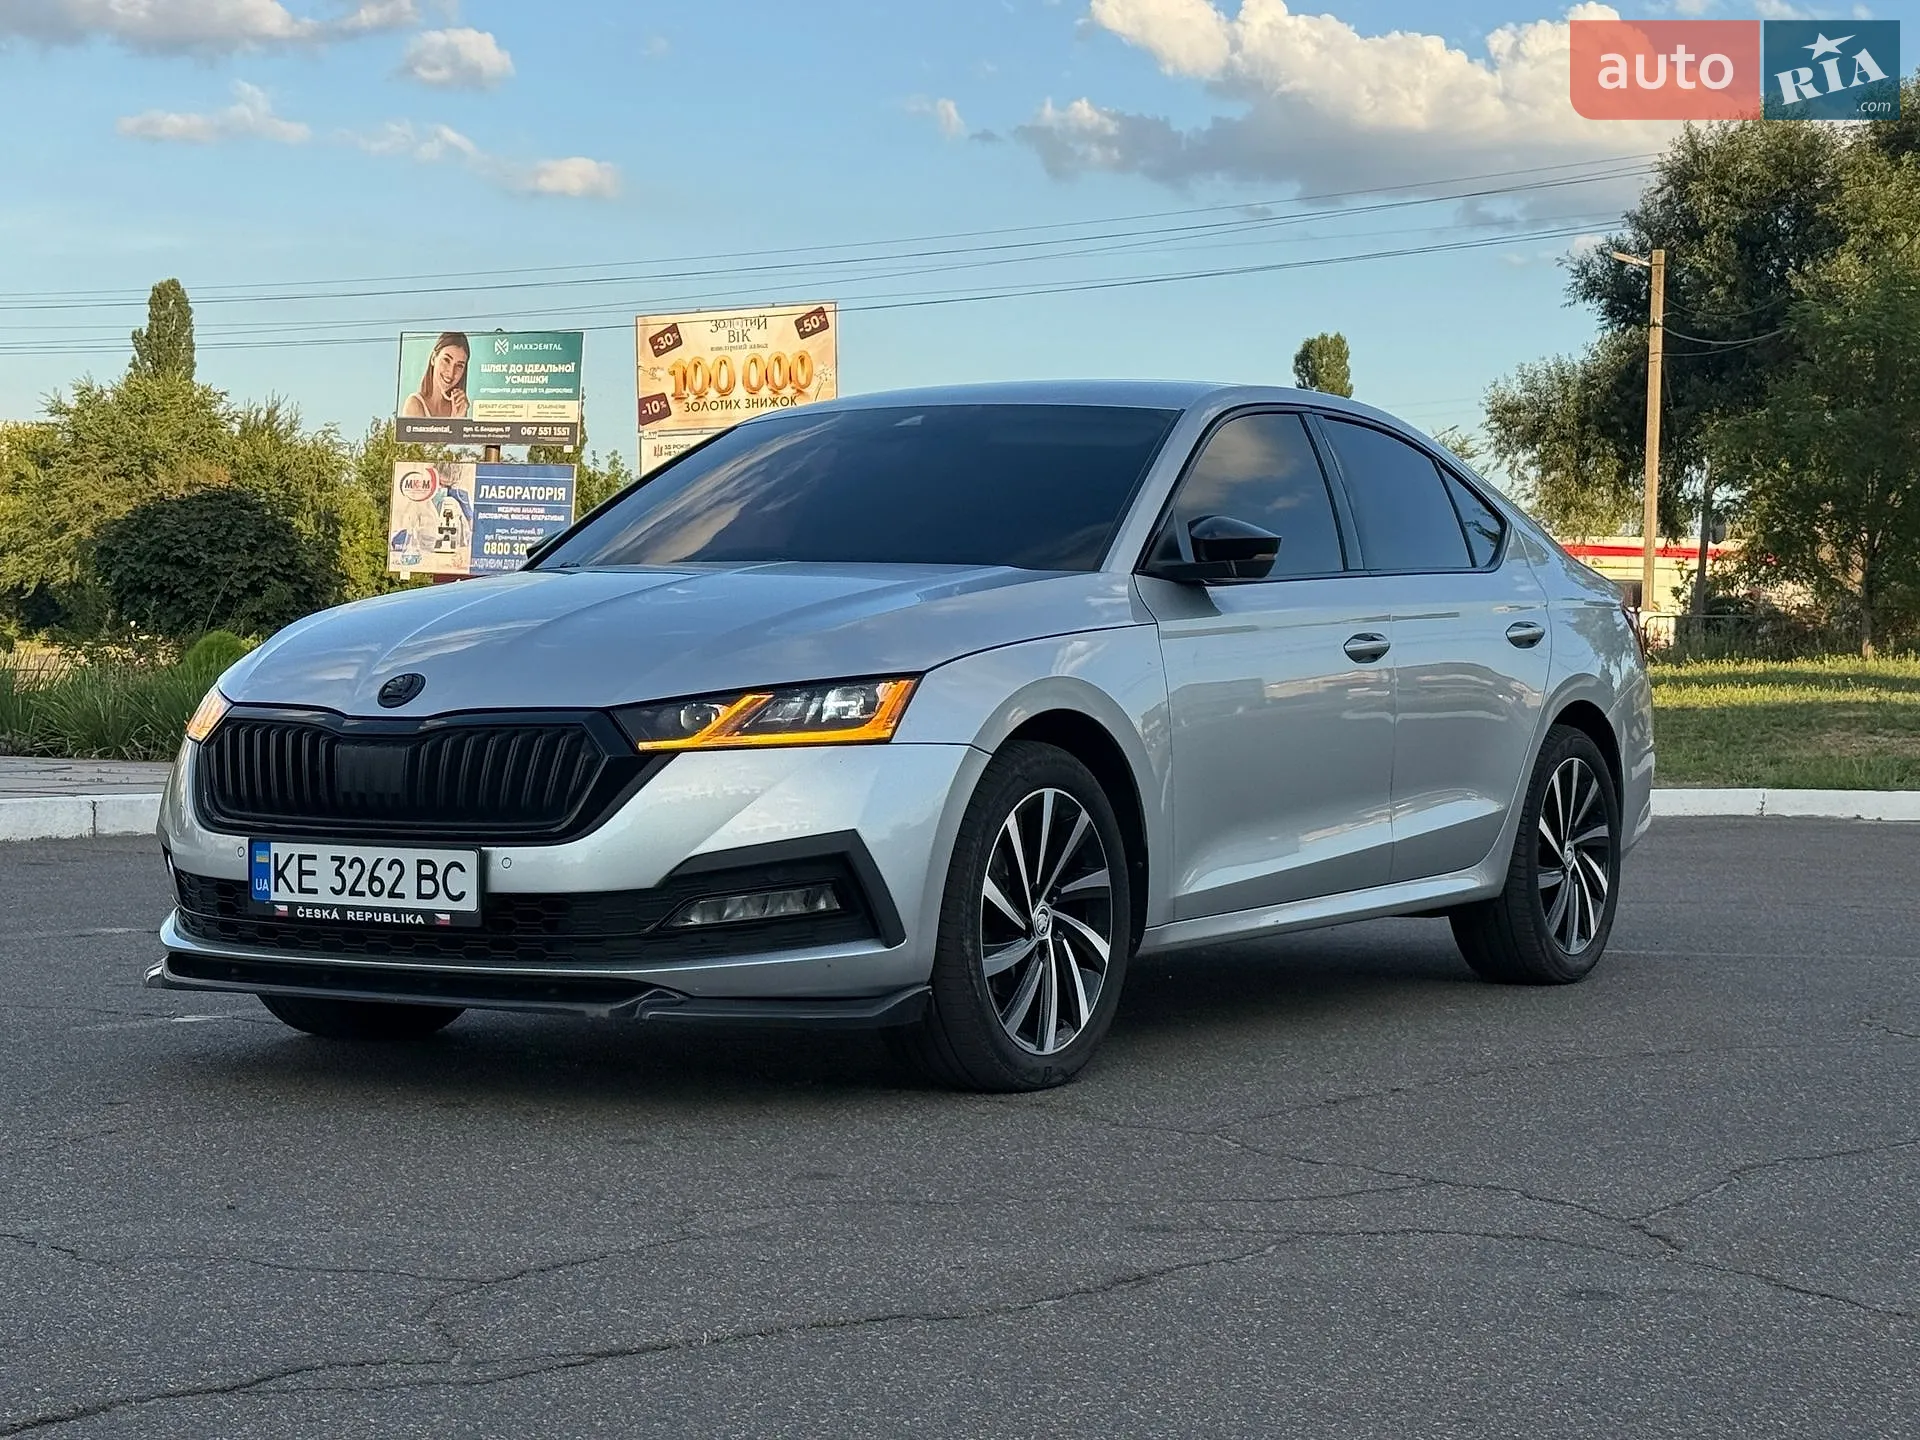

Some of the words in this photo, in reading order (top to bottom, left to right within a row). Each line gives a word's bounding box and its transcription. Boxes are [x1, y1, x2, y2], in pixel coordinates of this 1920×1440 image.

[480, 364, 508, 373] ШЛЯХ
[509, 364, 523, 374] ДО
[525, 362, 575, 373] ІДЕАЛЬНОЇ
[668, 355, 735, 399] 100
[743, 351, 814, 394] 000
[505, 375, 548, 384] УСМІШКИ
[684, 398, 740, 413] ЗОЛОТИХ
[745, 396, 797, 409] ЗНИЖОК
[520, 427, 537, 436] 067
[538, 427, 552, 437] 551
[553, 427, 570, 437] 1551
[479, 484, 566, 502] ЛАБОРАТОРІЯ
[483, 541, 511, 555] 0800
[273, 852, 318, 895] KE
[329, 855, 406, 900] 3262
[416, 858, 466, 902] BC
[255, 878, 270, 892] UA
[296, 906, 340, 920] ČESKÁ
[346, 910, 425, 925] REPUBLIKA
